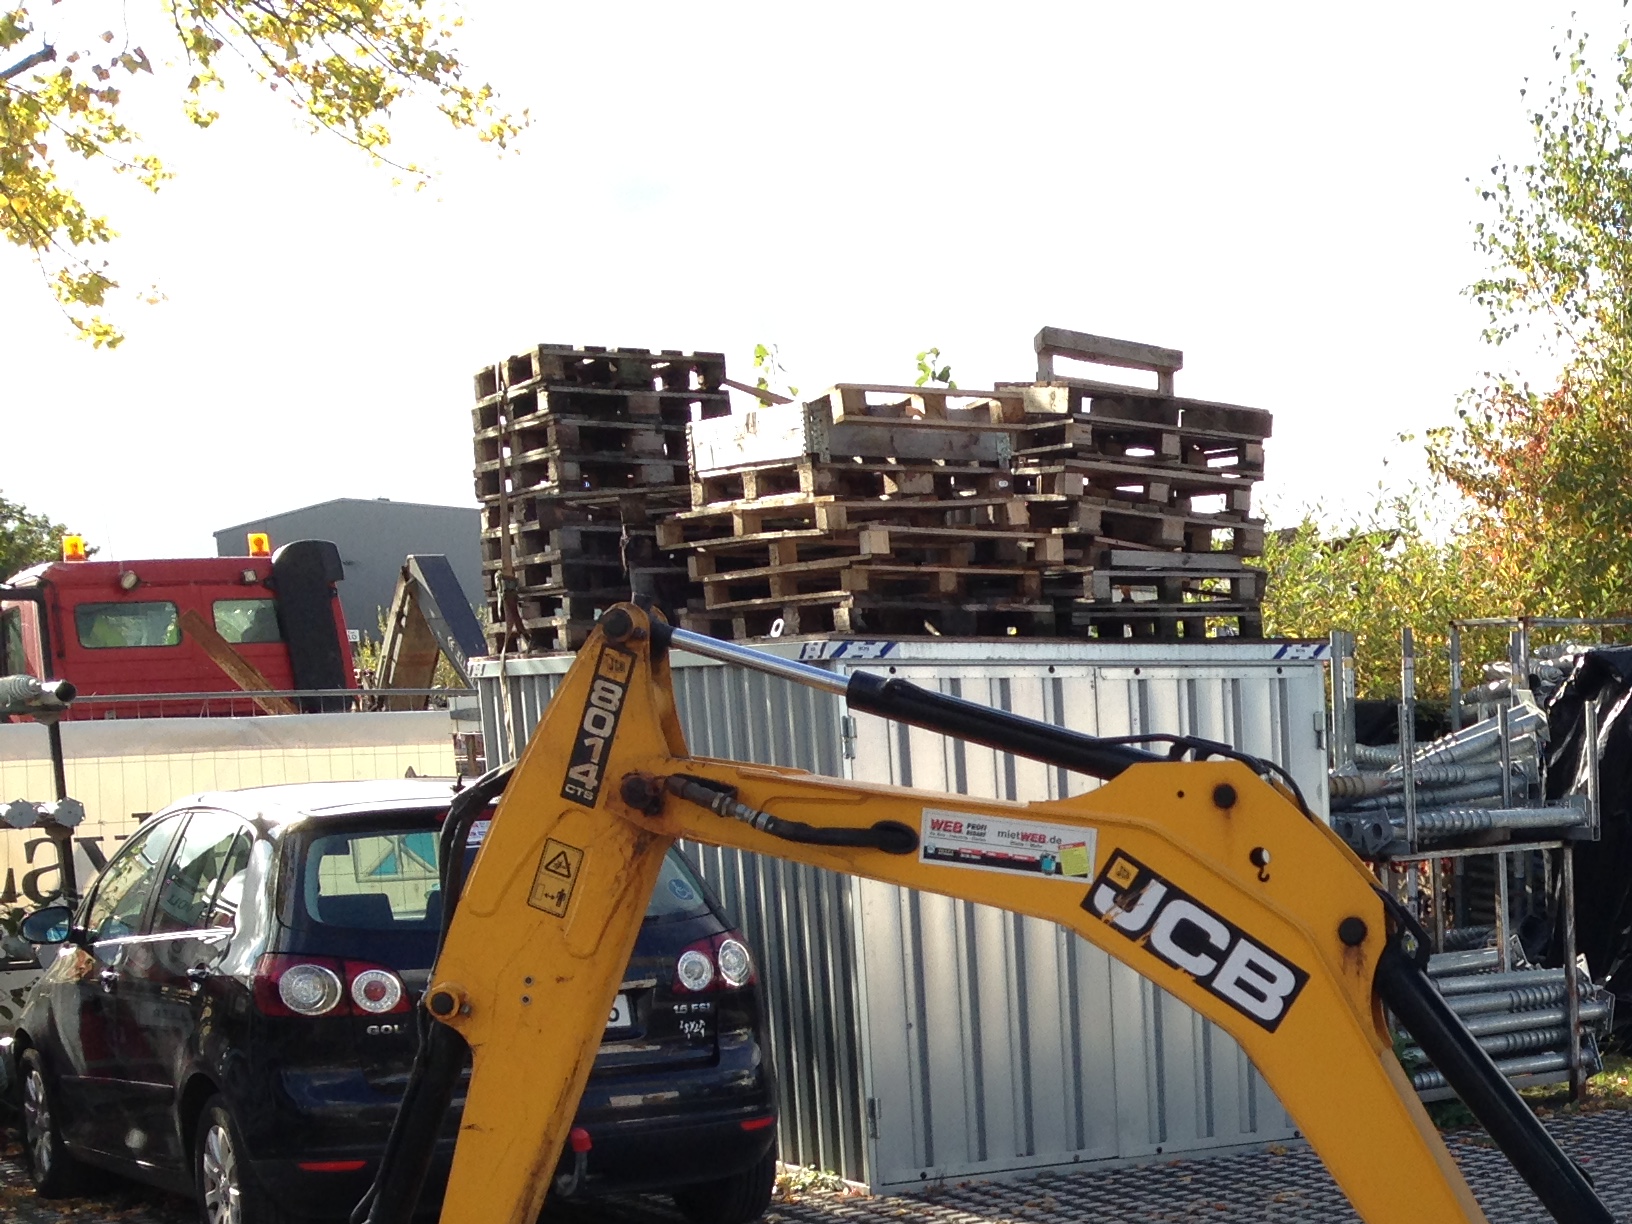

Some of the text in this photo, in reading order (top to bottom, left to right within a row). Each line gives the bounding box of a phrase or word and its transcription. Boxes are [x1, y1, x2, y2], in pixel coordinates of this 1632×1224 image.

[931, 818, 964, 834] WEB
[997, 829, 1063, 845] mietWEB.de
[1094, 878, 1297, 1022] JCB
